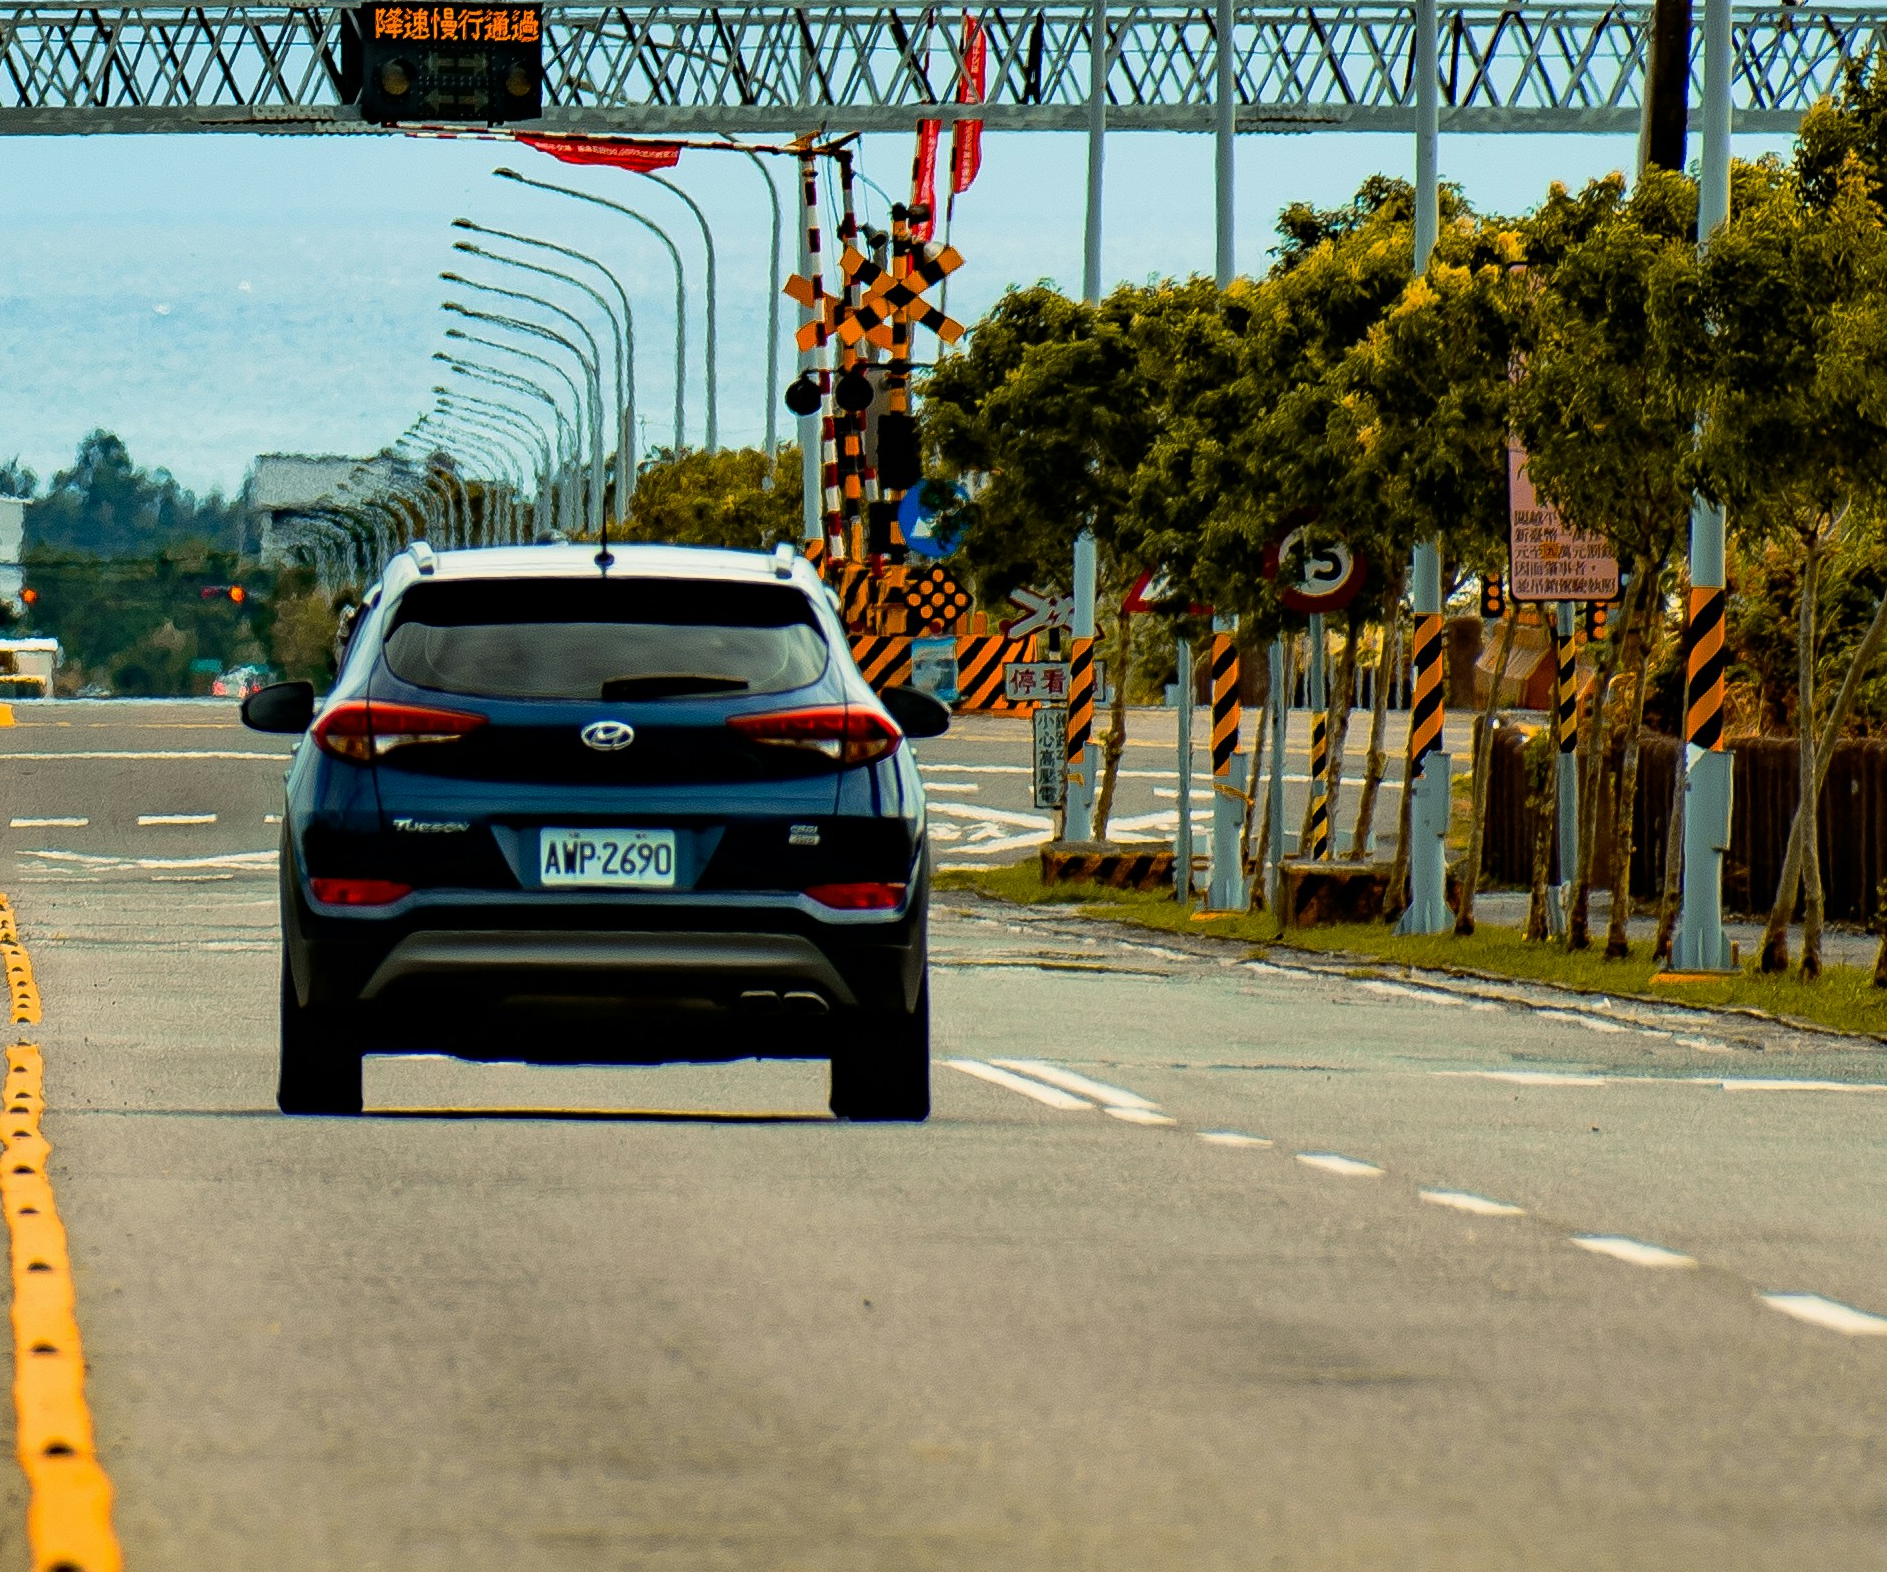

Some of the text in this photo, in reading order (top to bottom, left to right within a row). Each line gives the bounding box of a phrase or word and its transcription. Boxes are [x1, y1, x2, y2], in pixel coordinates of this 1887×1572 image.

[374, 7, 539, 43] 降速慢行通過
[1009, 668, 1099, 695] 停看
